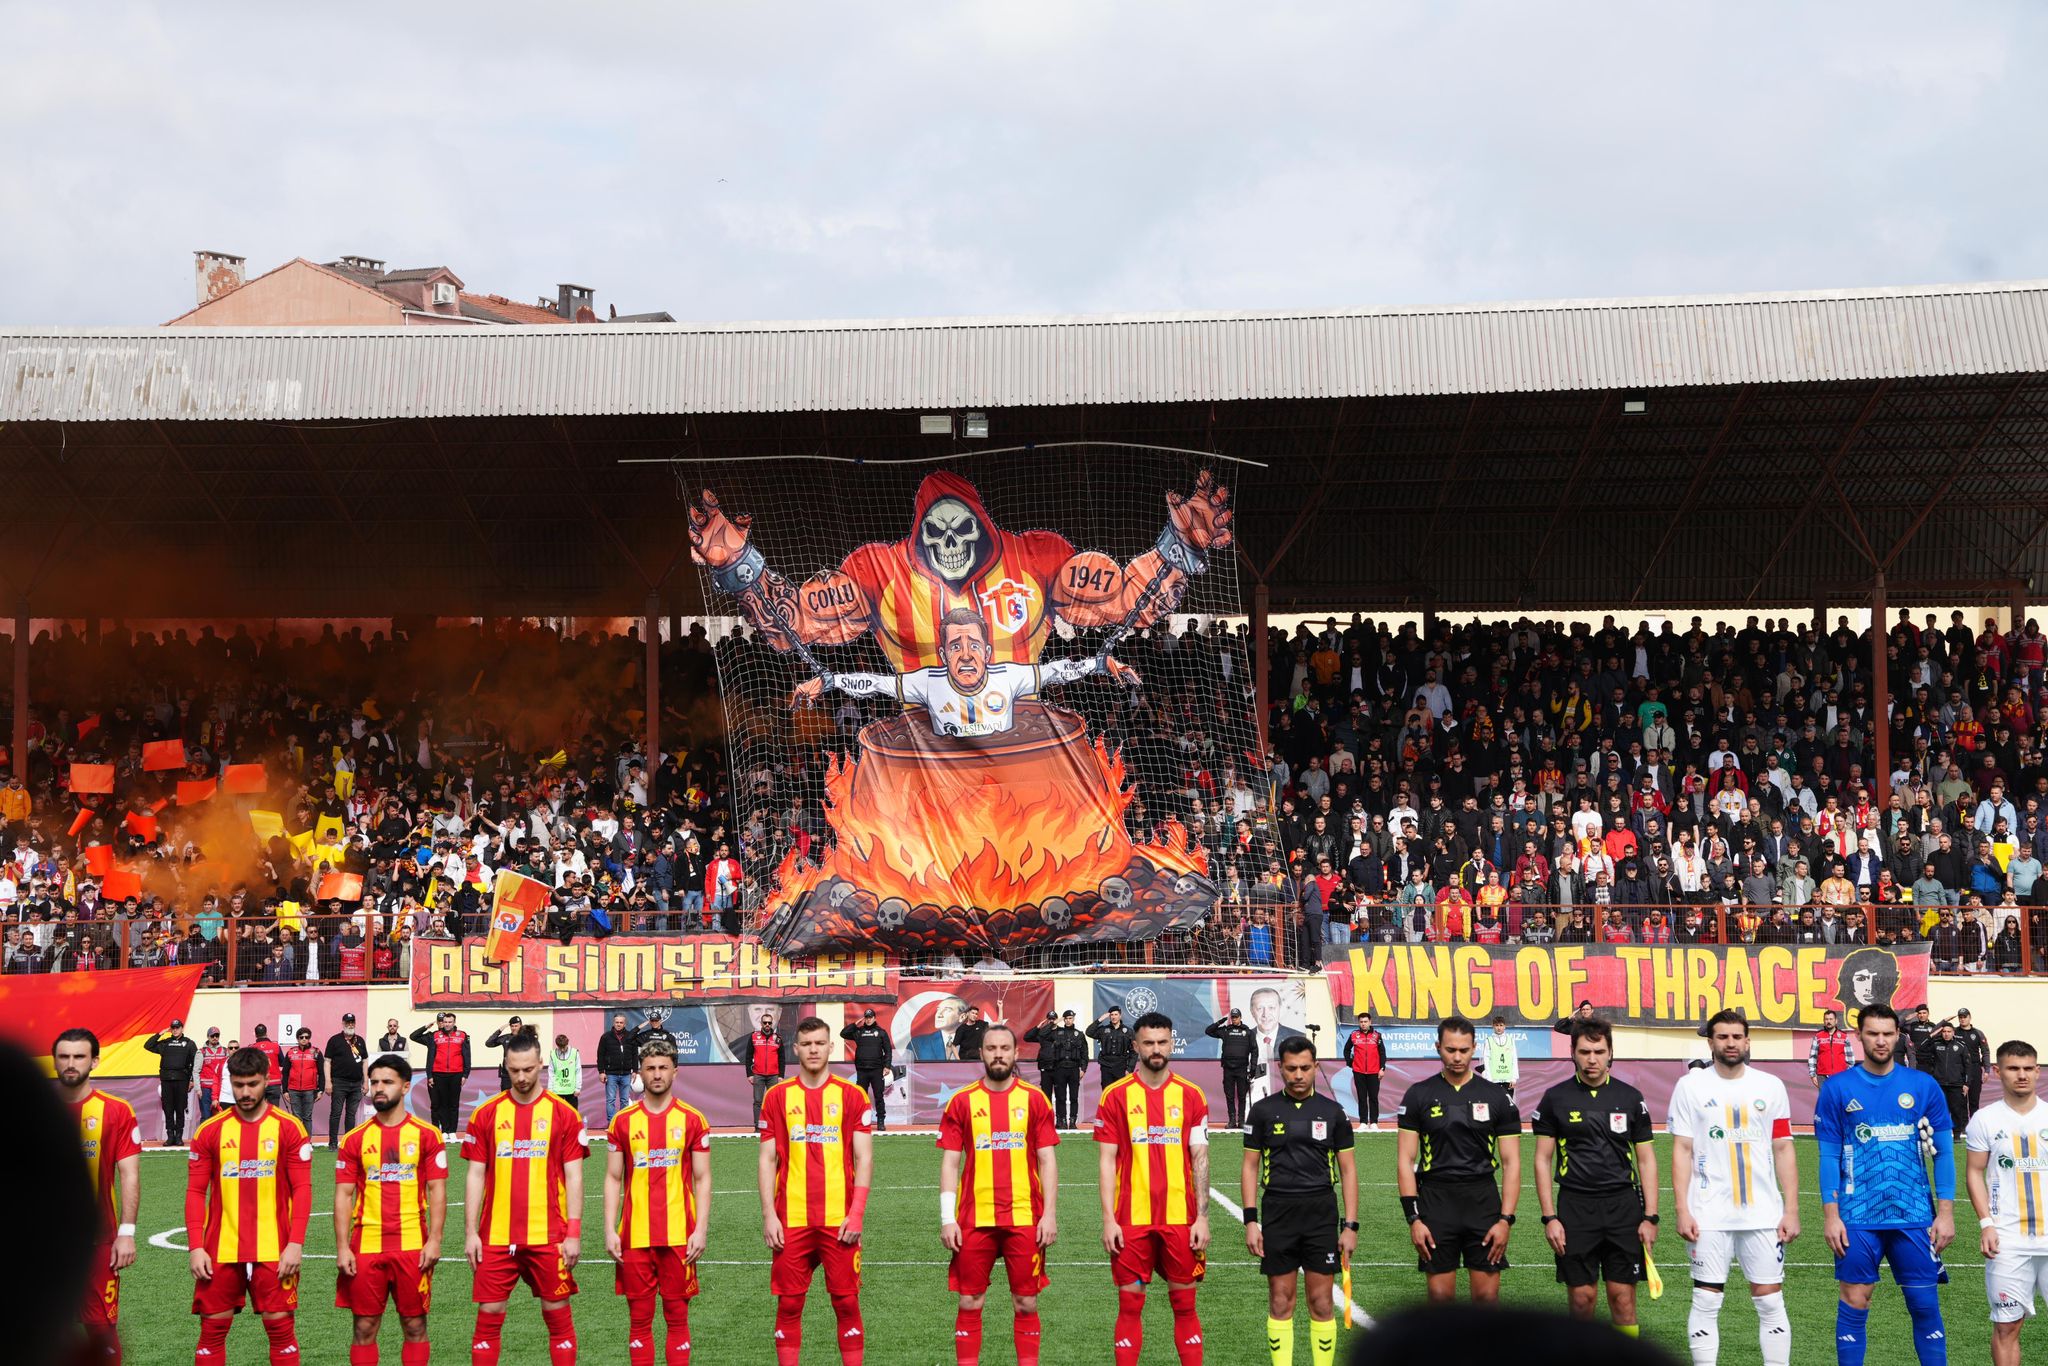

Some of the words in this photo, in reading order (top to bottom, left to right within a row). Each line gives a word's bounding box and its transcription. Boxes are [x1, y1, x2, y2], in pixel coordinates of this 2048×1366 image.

[1069, 565, 1116, 593] 1947
[807, 582, 855, 613] ÇORLU
[1348, 945, 1494, 1020] KING
[1515, 945, 1589, 1021] OF
[1615, 945, 1830, 1024] THRACE
[285, 1024, 293, 1036] 9
[1381, 1031, 1430, 1041] ANTRENÖR
[1499, 1053, 1506, 1064] 4
[561, 1067, 570, 1079] 10
[853, 1250, 862, 1279] 6
[1775, 1241, 1784, 1263] 3
[1030, 1253, 1043, 1278] 2
[104, 1279, 116, 1304] 5
[418, 1272, 431, 1297] 4
